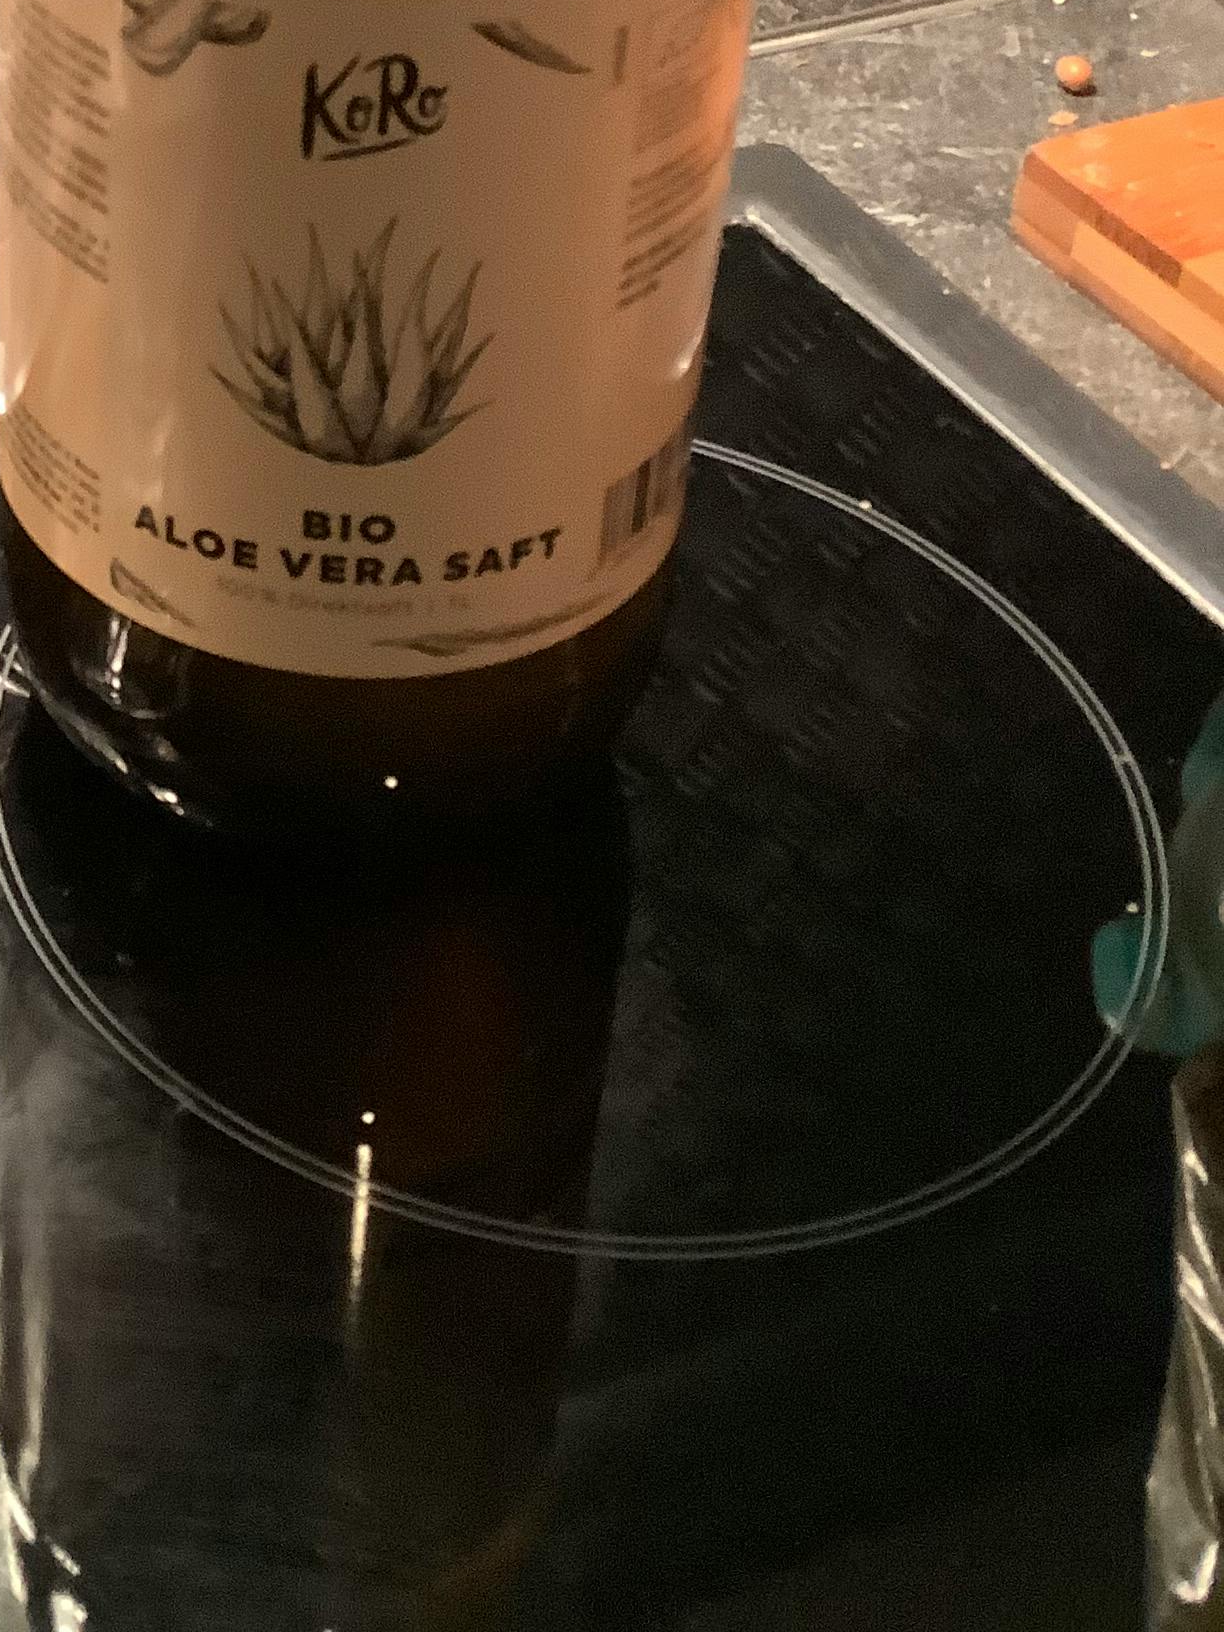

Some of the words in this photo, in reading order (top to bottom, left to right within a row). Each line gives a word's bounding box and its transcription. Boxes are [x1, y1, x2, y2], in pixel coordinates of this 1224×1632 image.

[300, 53, 448, 160] KoRo
[134, 504, 259, 571] ALOE
[279, 548, 422, 587] VERA
[442, 525, 563, 582] SAFT
[302, 509, 396, 545] BIO
